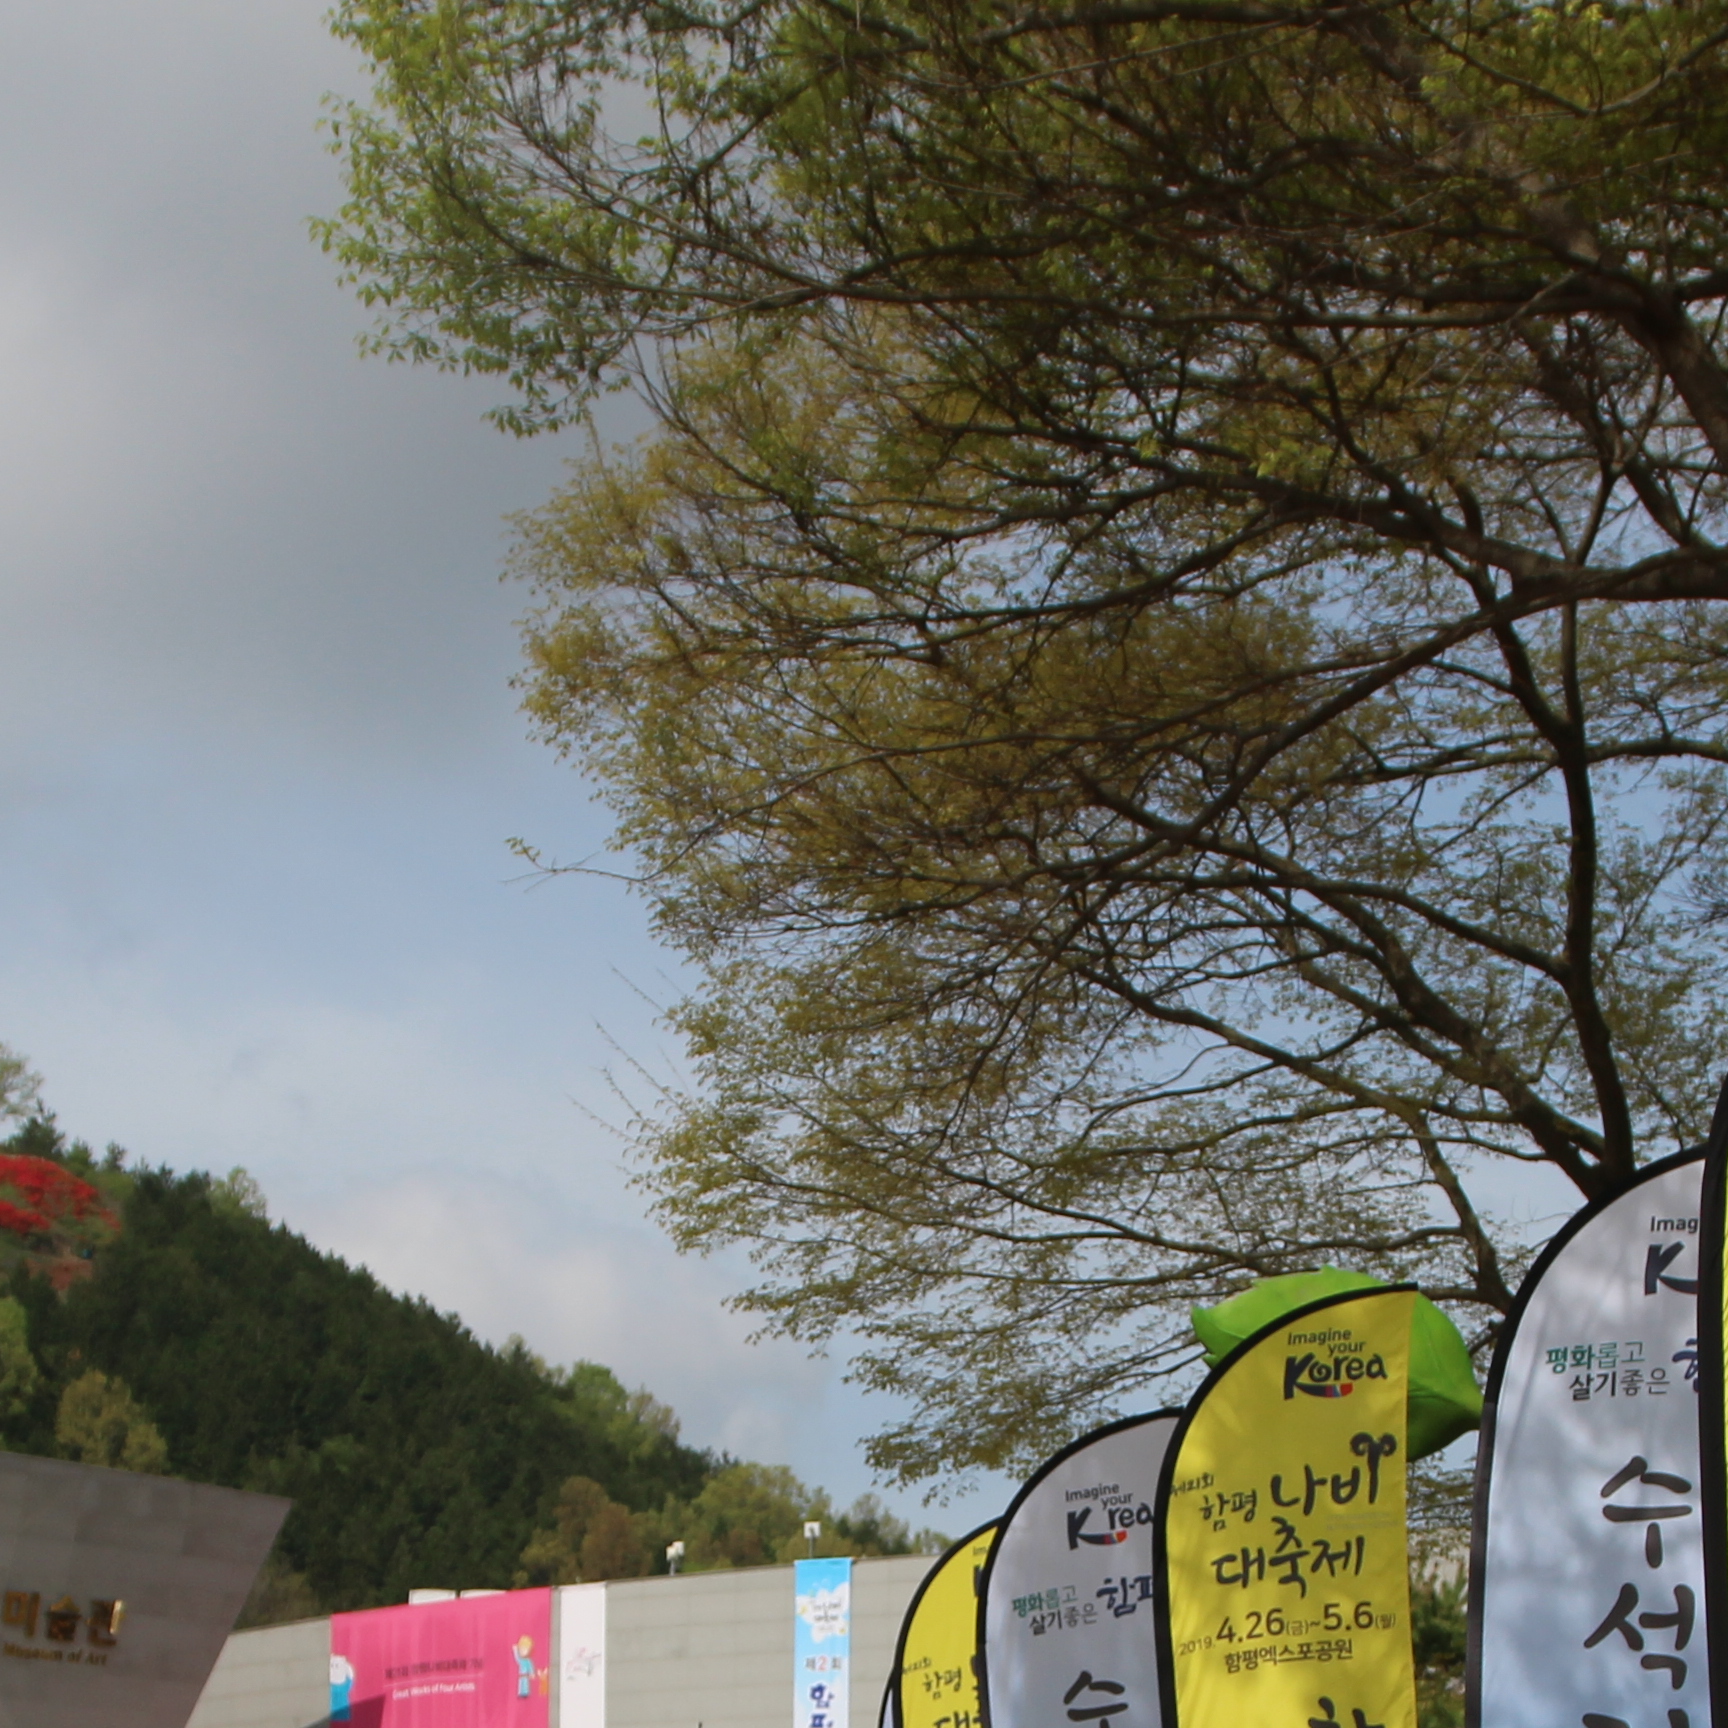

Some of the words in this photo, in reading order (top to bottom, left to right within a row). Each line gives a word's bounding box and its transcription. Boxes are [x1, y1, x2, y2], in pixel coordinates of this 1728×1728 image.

[1287, 1327, 1352, 1347] Imagine
[1327, 1339, 1366, 1358] your
[1545, 1341, 1646, 1375] 평화롭고
[1283, 1351, 1388, 1400] Korea
[1569, 1367, 1671, 1401] 살기좋은
[1065, 1482, 1120, 1503] Imagine
[1099, 1490, 1134, 1511] your
[1199, 1489, 1259, 1532] 함평
[1271, 1456, 1382, 1516] 나비
[1210, 1516, 1366, 1599] 대축제
[1012, 1585, 1078, 1619] 평화롭고
[1028, 1603, 1099, 1637] 살기좋은
[1224, 1638, 1354, 1674] 함평엑스포공원
[922, 1666, 963, 1700] 함평
